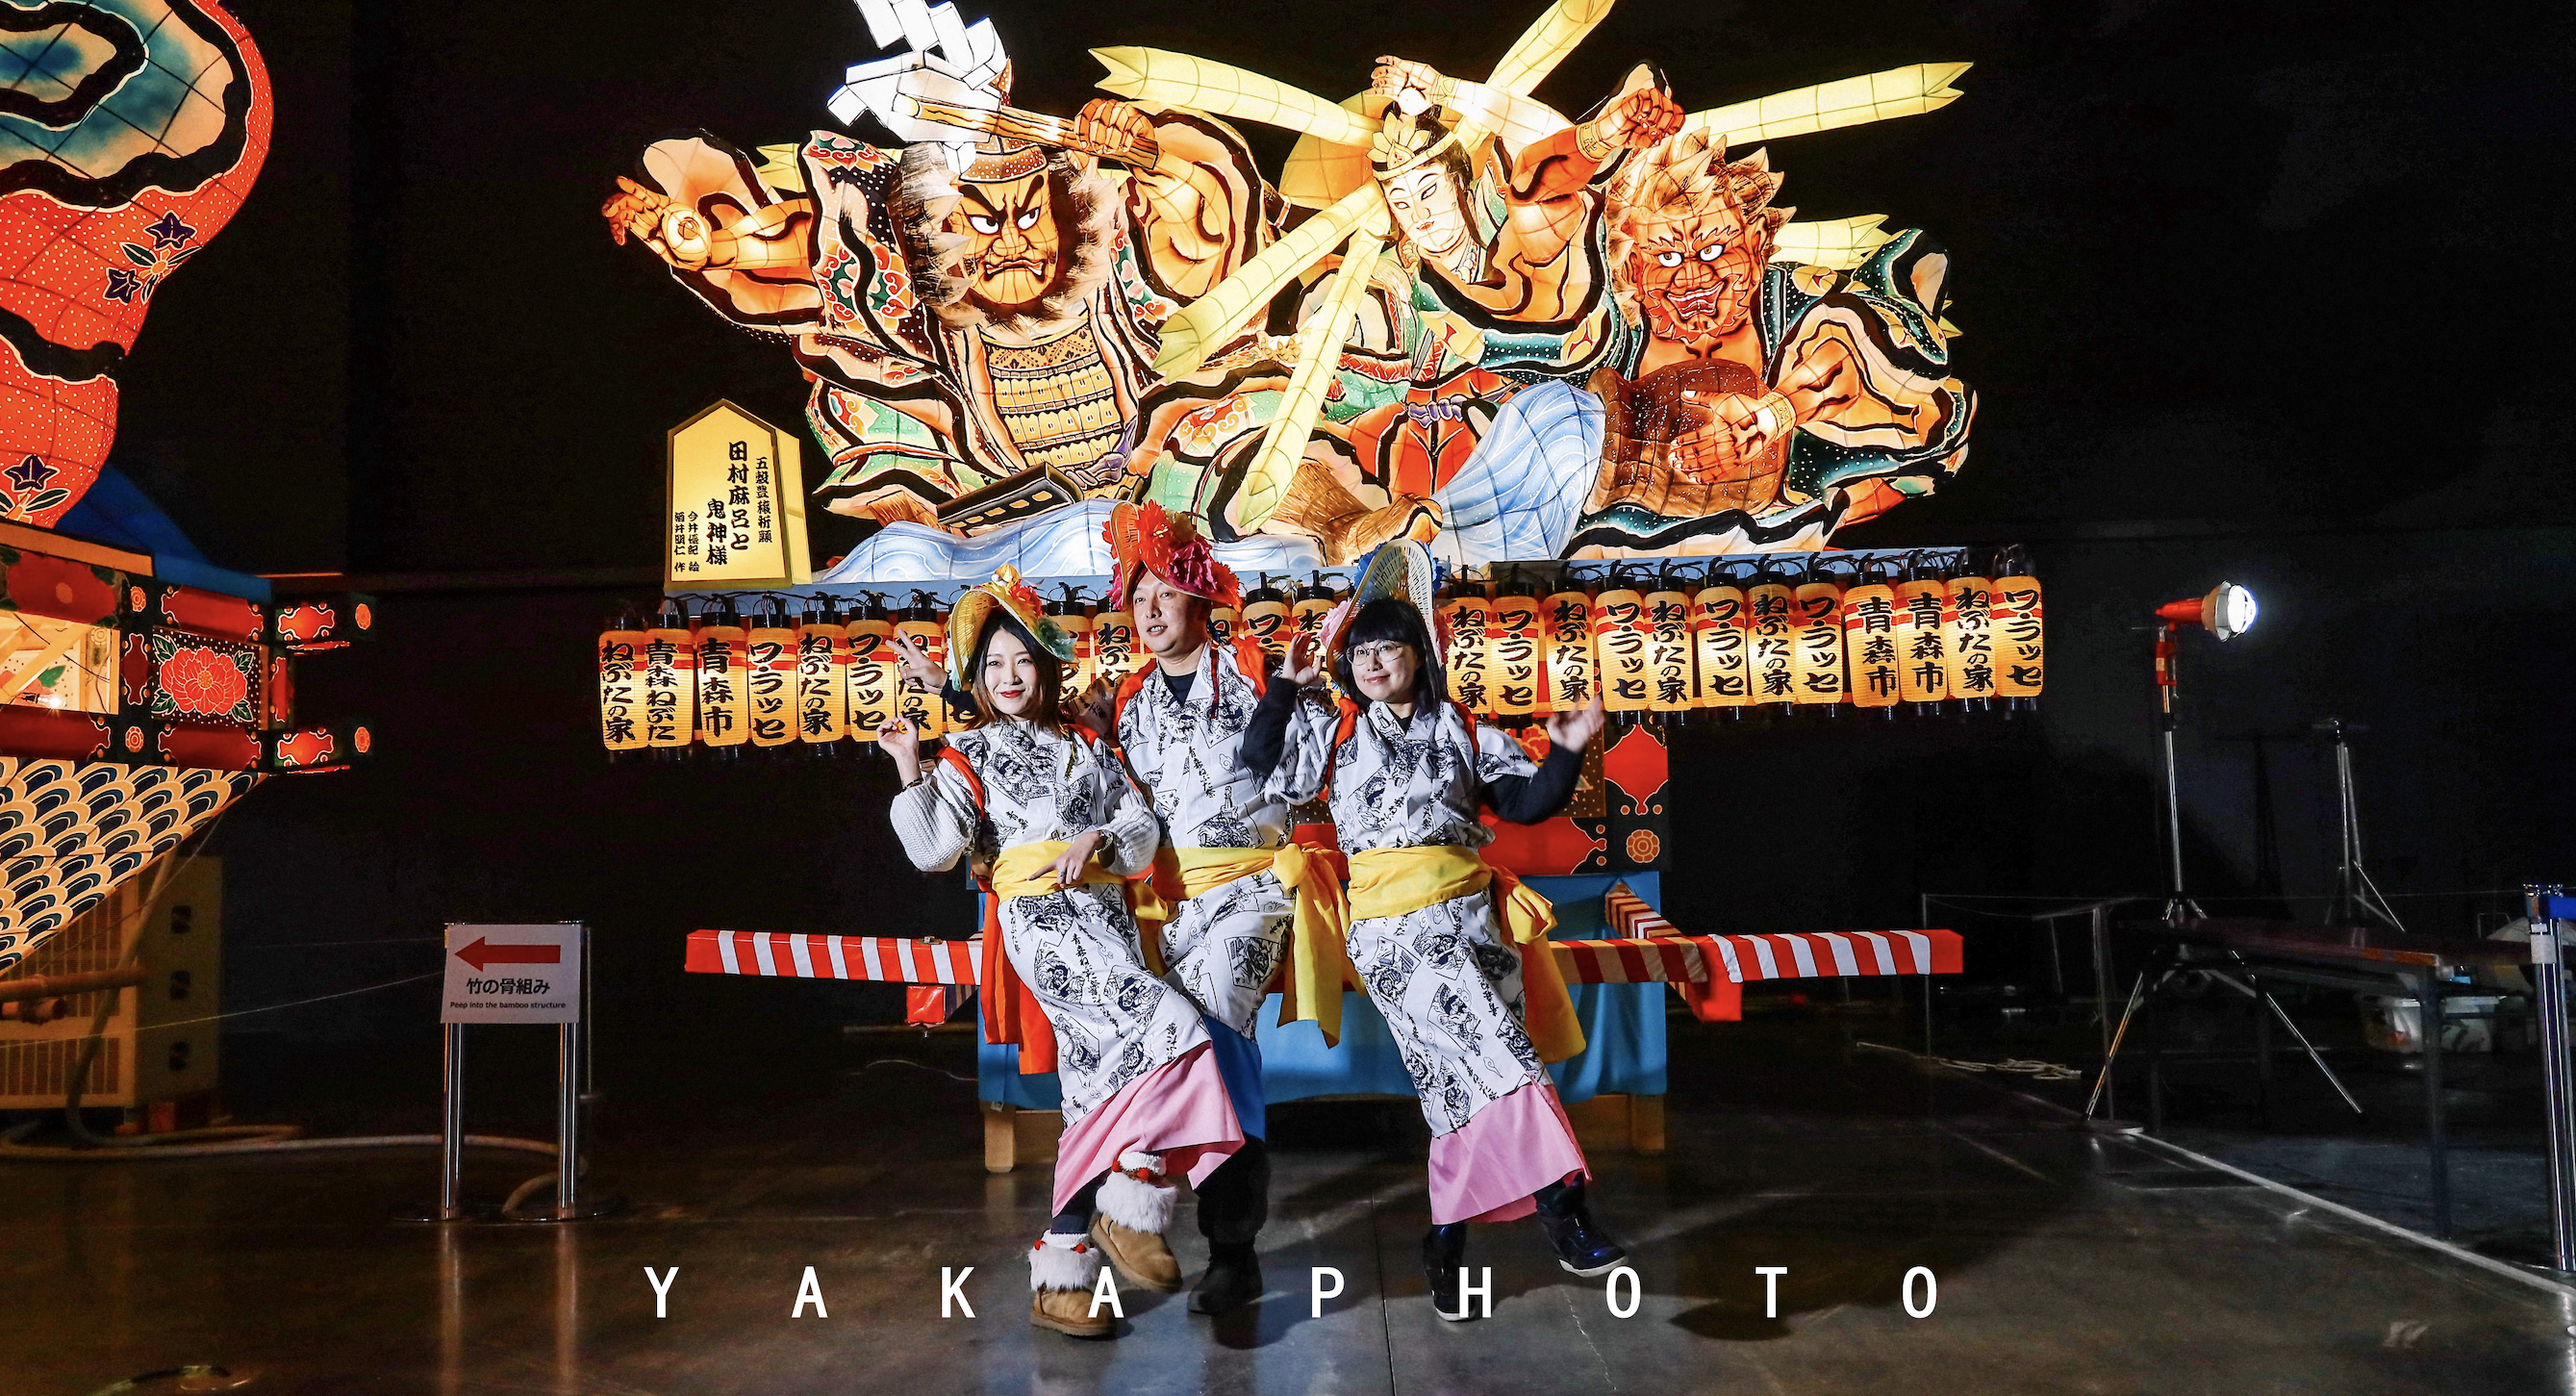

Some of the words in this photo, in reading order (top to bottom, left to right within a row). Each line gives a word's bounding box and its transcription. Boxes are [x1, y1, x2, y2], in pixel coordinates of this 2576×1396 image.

[706, 498, 728, 566] 鬼神様
[727, 441, 750, 551] 田村麻呂と
[674, 561, 686, 572] 作
[645, 638, 678, 741] 青森ねぶた
[698, 637, 734, 738] 青森市
[799, 632, 834, 735] ねぶたの家
[1451, 605, 1487, 709] ねぶたの家
[1553, 600, 1590, 701] ねぶたの家
[1650, 600, 1688, 704] ねぶたの家
[1754, 594, 1794, 696] ねぶたの家
[1857, 596, 1897, 698] 青森市
[1907, 592, 1945, 694] 青森市
[1955, 587, 1994, 693] ねぶたの家
[601, 640, 635, 743] ねぶたの家
[450, 1002, 468, 1010] Peep
[467, 977, 550, 995] 竹の骨組み
